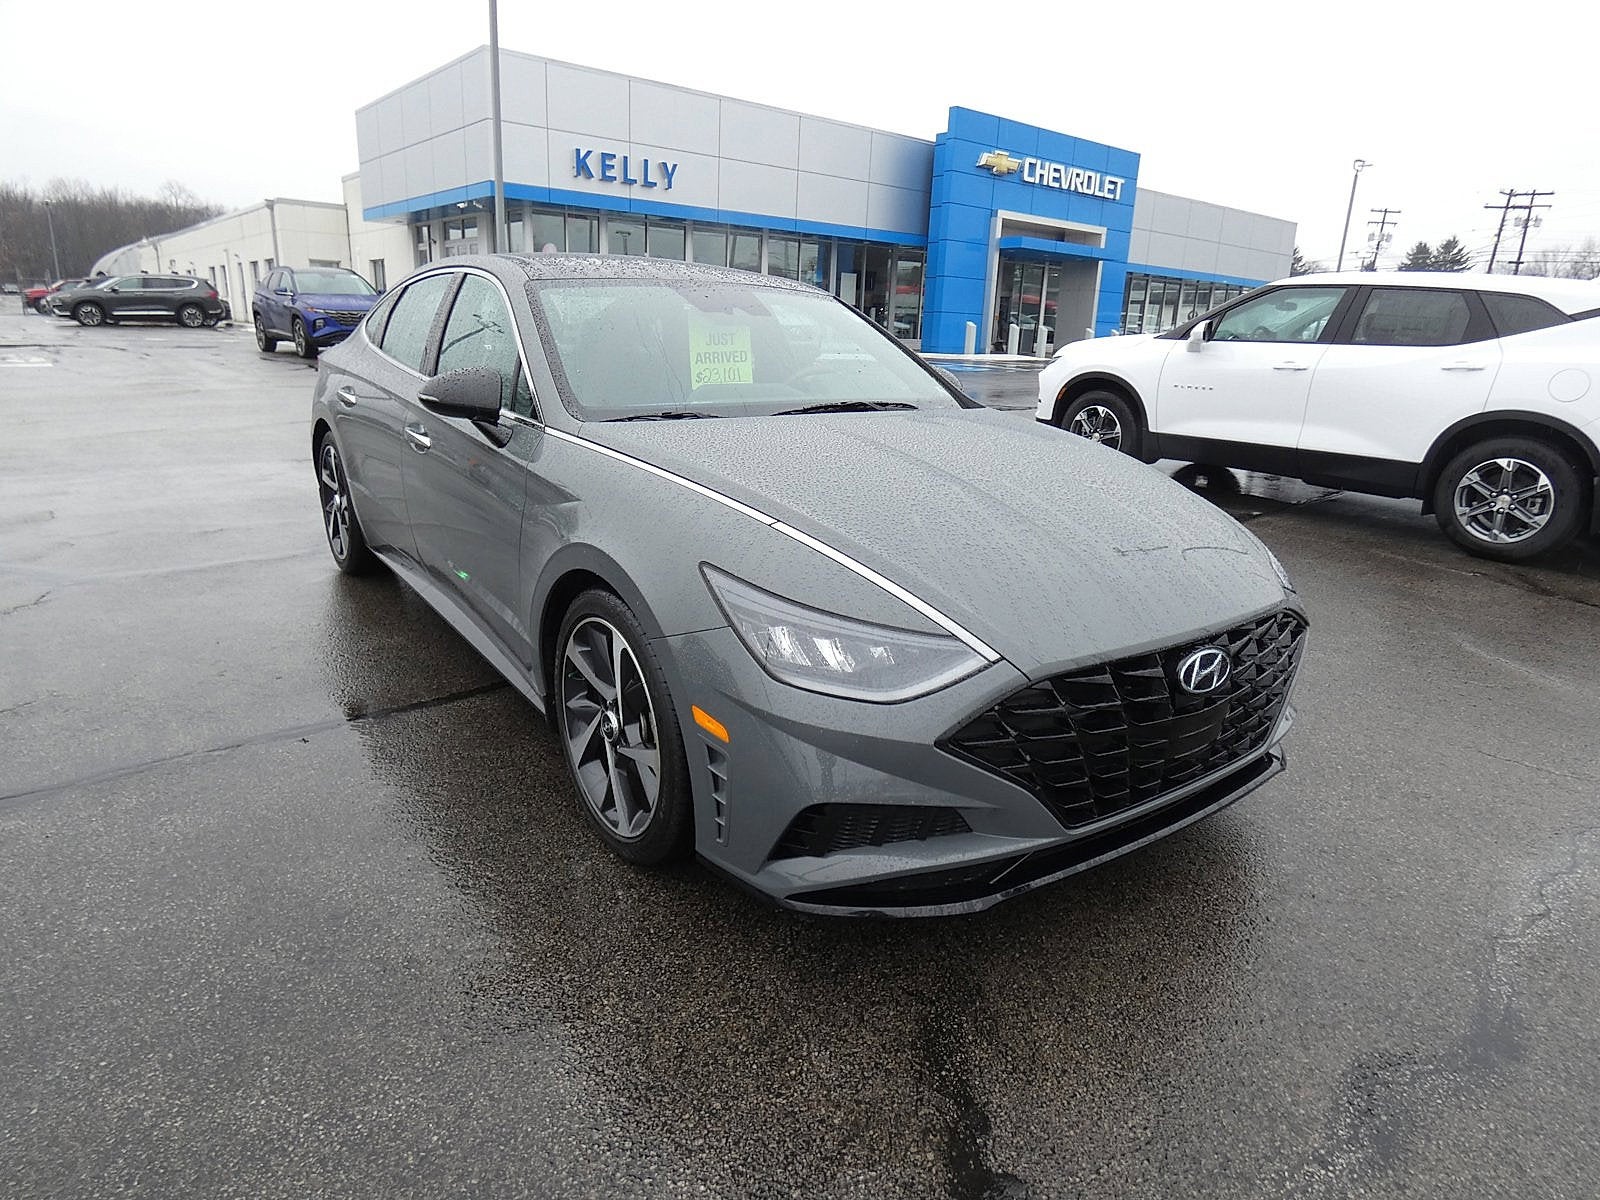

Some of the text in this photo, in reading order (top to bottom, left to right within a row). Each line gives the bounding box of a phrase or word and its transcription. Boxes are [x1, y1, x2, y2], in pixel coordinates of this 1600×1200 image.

[574, 148, 678, 190] KELLY
[1023, 157, 1125, 201] CHEVROLET
[705, 331, 736, 346] JUST
[695, 350, 748, 365] ARRIVED
